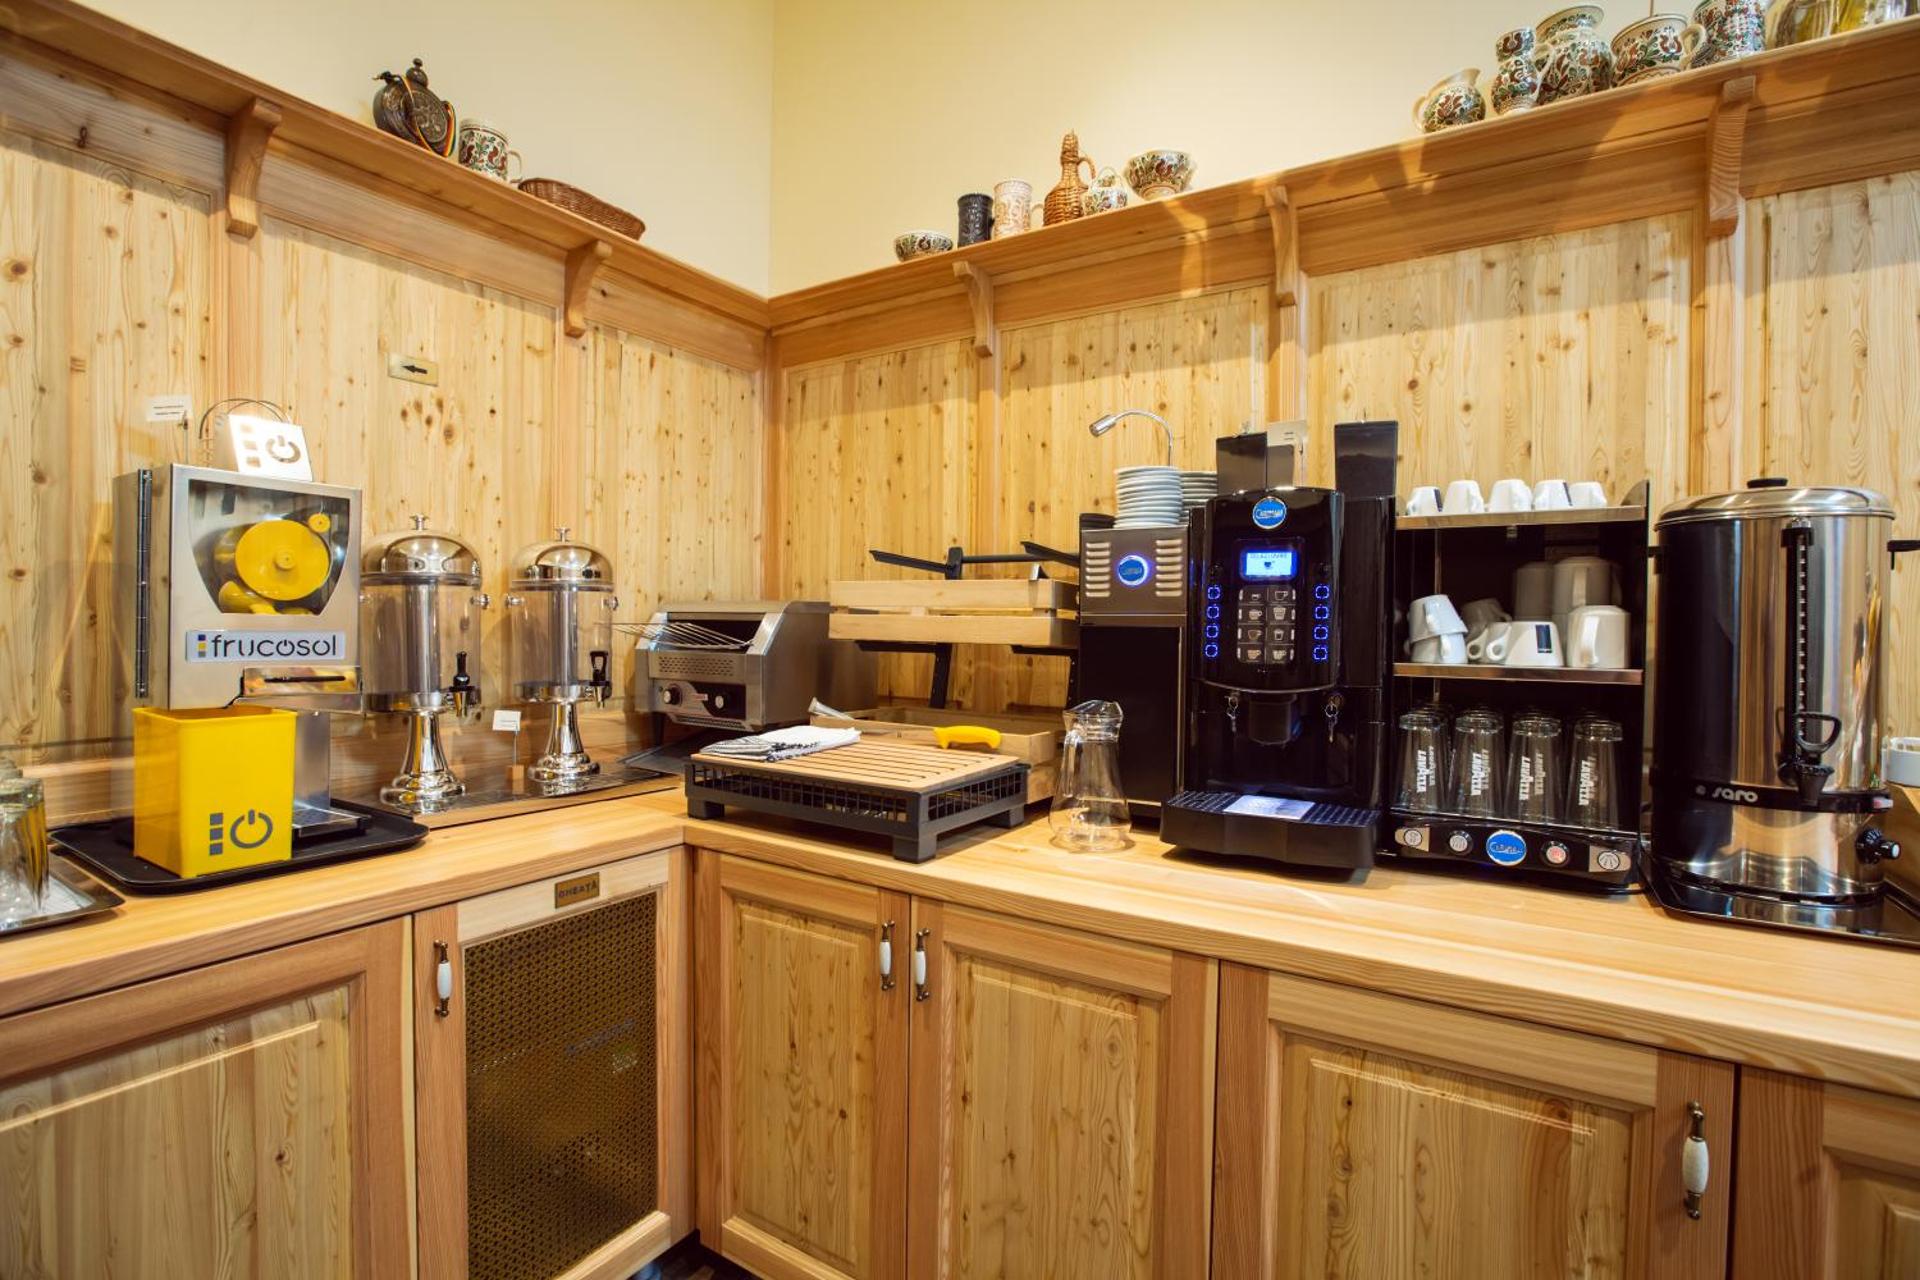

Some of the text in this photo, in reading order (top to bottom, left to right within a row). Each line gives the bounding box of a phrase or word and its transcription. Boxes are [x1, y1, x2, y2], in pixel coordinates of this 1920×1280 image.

[211, 634, 336, 658] frucosol
[1416, 750, 1431, 793] LAVAZZA
[1470, 753, 1488, 796] LAVAZZA
[1519, 755, 1534, 801] LAVAZZA
[1578, 759, 1596, 807] LAVAZZA
[1712, 787, 1759, 803] saro
